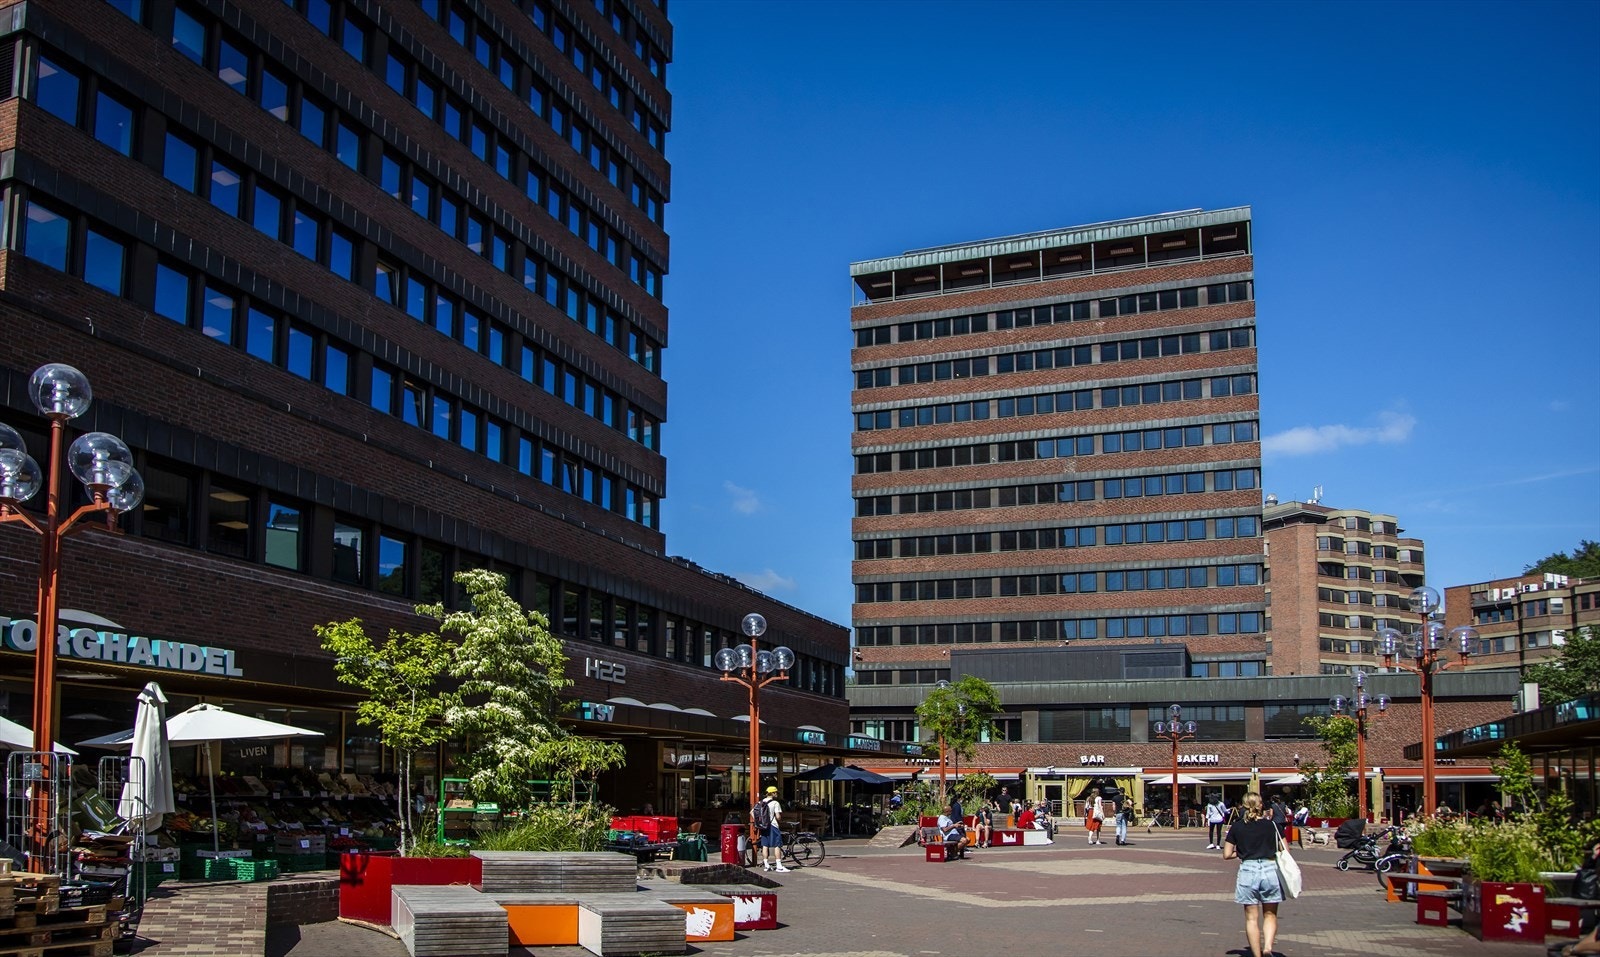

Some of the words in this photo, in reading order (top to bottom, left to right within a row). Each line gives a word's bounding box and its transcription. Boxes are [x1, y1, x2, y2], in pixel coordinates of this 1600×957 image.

[586, 657, 626, 684] H22
[1080, 755, 1105, 763] BAR
[1177, 754, 1219, 763] BAKERI
